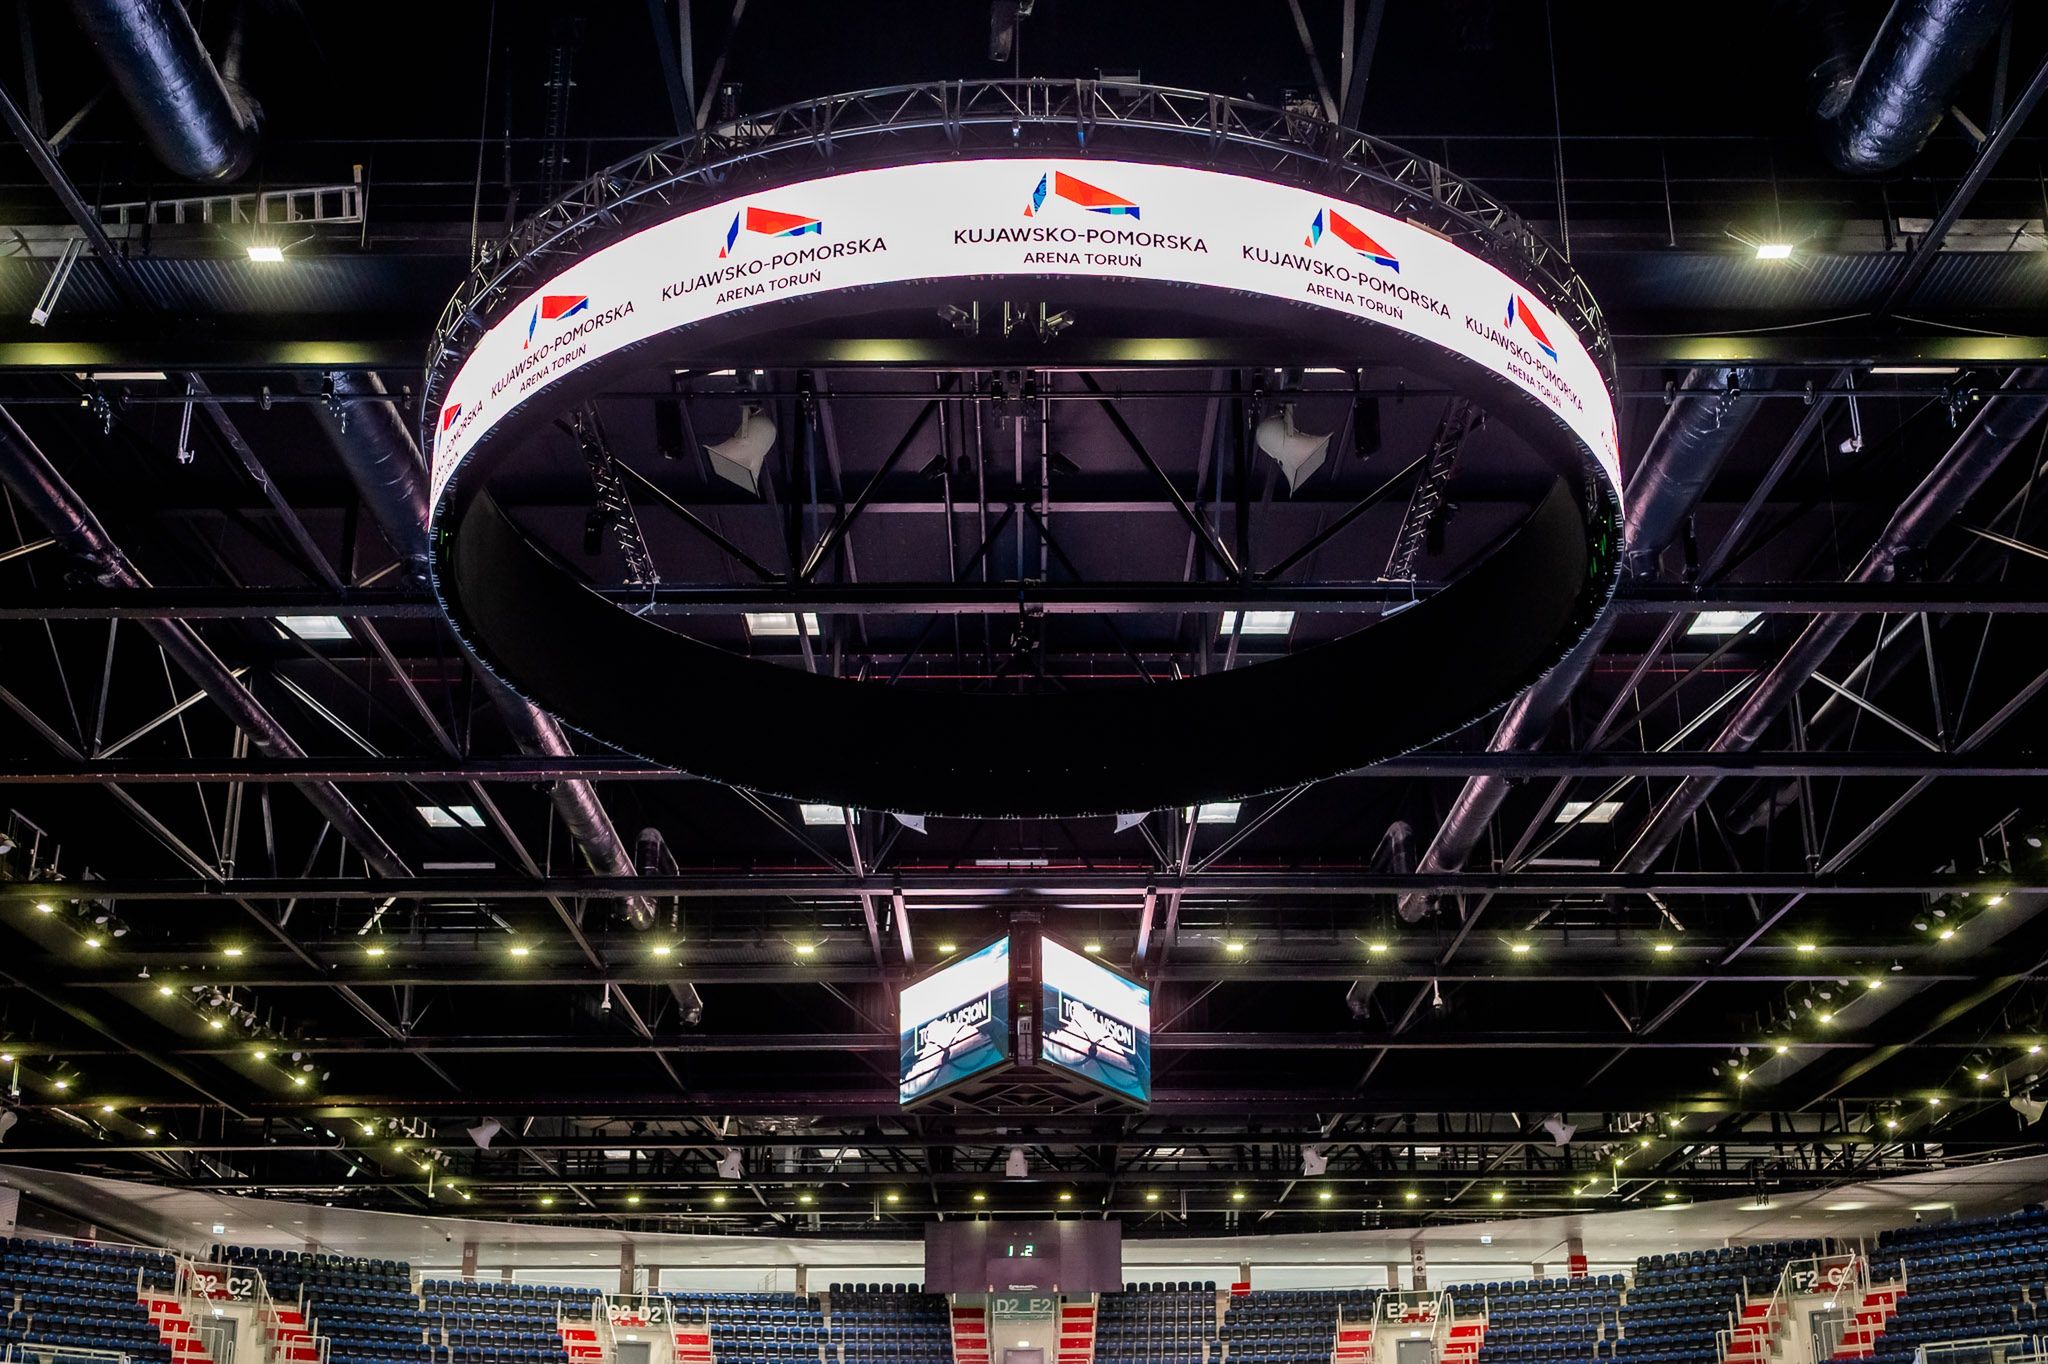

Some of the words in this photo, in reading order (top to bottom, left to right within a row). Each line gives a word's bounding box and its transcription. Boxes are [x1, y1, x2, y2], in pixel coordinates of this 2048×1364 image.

[954, 227, 1209, 253] KUJAWSKO-POMORSKA
[661, 237, 887, 302] KUJAWSKO-POMORSKA
[1023, 252, 1080, 264] ARENA
[1084, 253, 1142, 268] TORUŃ
[716, 283, 765, 305] ARENA
[769, 268, 821, 291] TORUŃ
[1242, 245, 1451, 320] KUJAWSKO-POMORSKA
[1306, 282, 1355, 305] ARENA
[1357, 295, 1403, 320] TORUŃ
[491, 301, 635, 399] KUJAWSKO-POMORSKA
[519, 366, 549, 394] ARENA
[552, 343, 587, 371] TORUŃ
[1465, 315, 1584, 413] KUJAWSKO-POMORSKA
[1507, 361, 1535, 386] ARENA
[1537, 380, 1562, 409] TORUŃ
[227, 1277, 252, 1295] C2
[1796, 1270, 1819, 1288] F2
[638, 1306, 661, 1322] D2
[997, 1299, 1019, 1313] D2
[1030, 1299, 1051, 1313] E2
[1387, 1302, 1409, 1318] E2
[1418, 1300, 1439, 1316] F2
